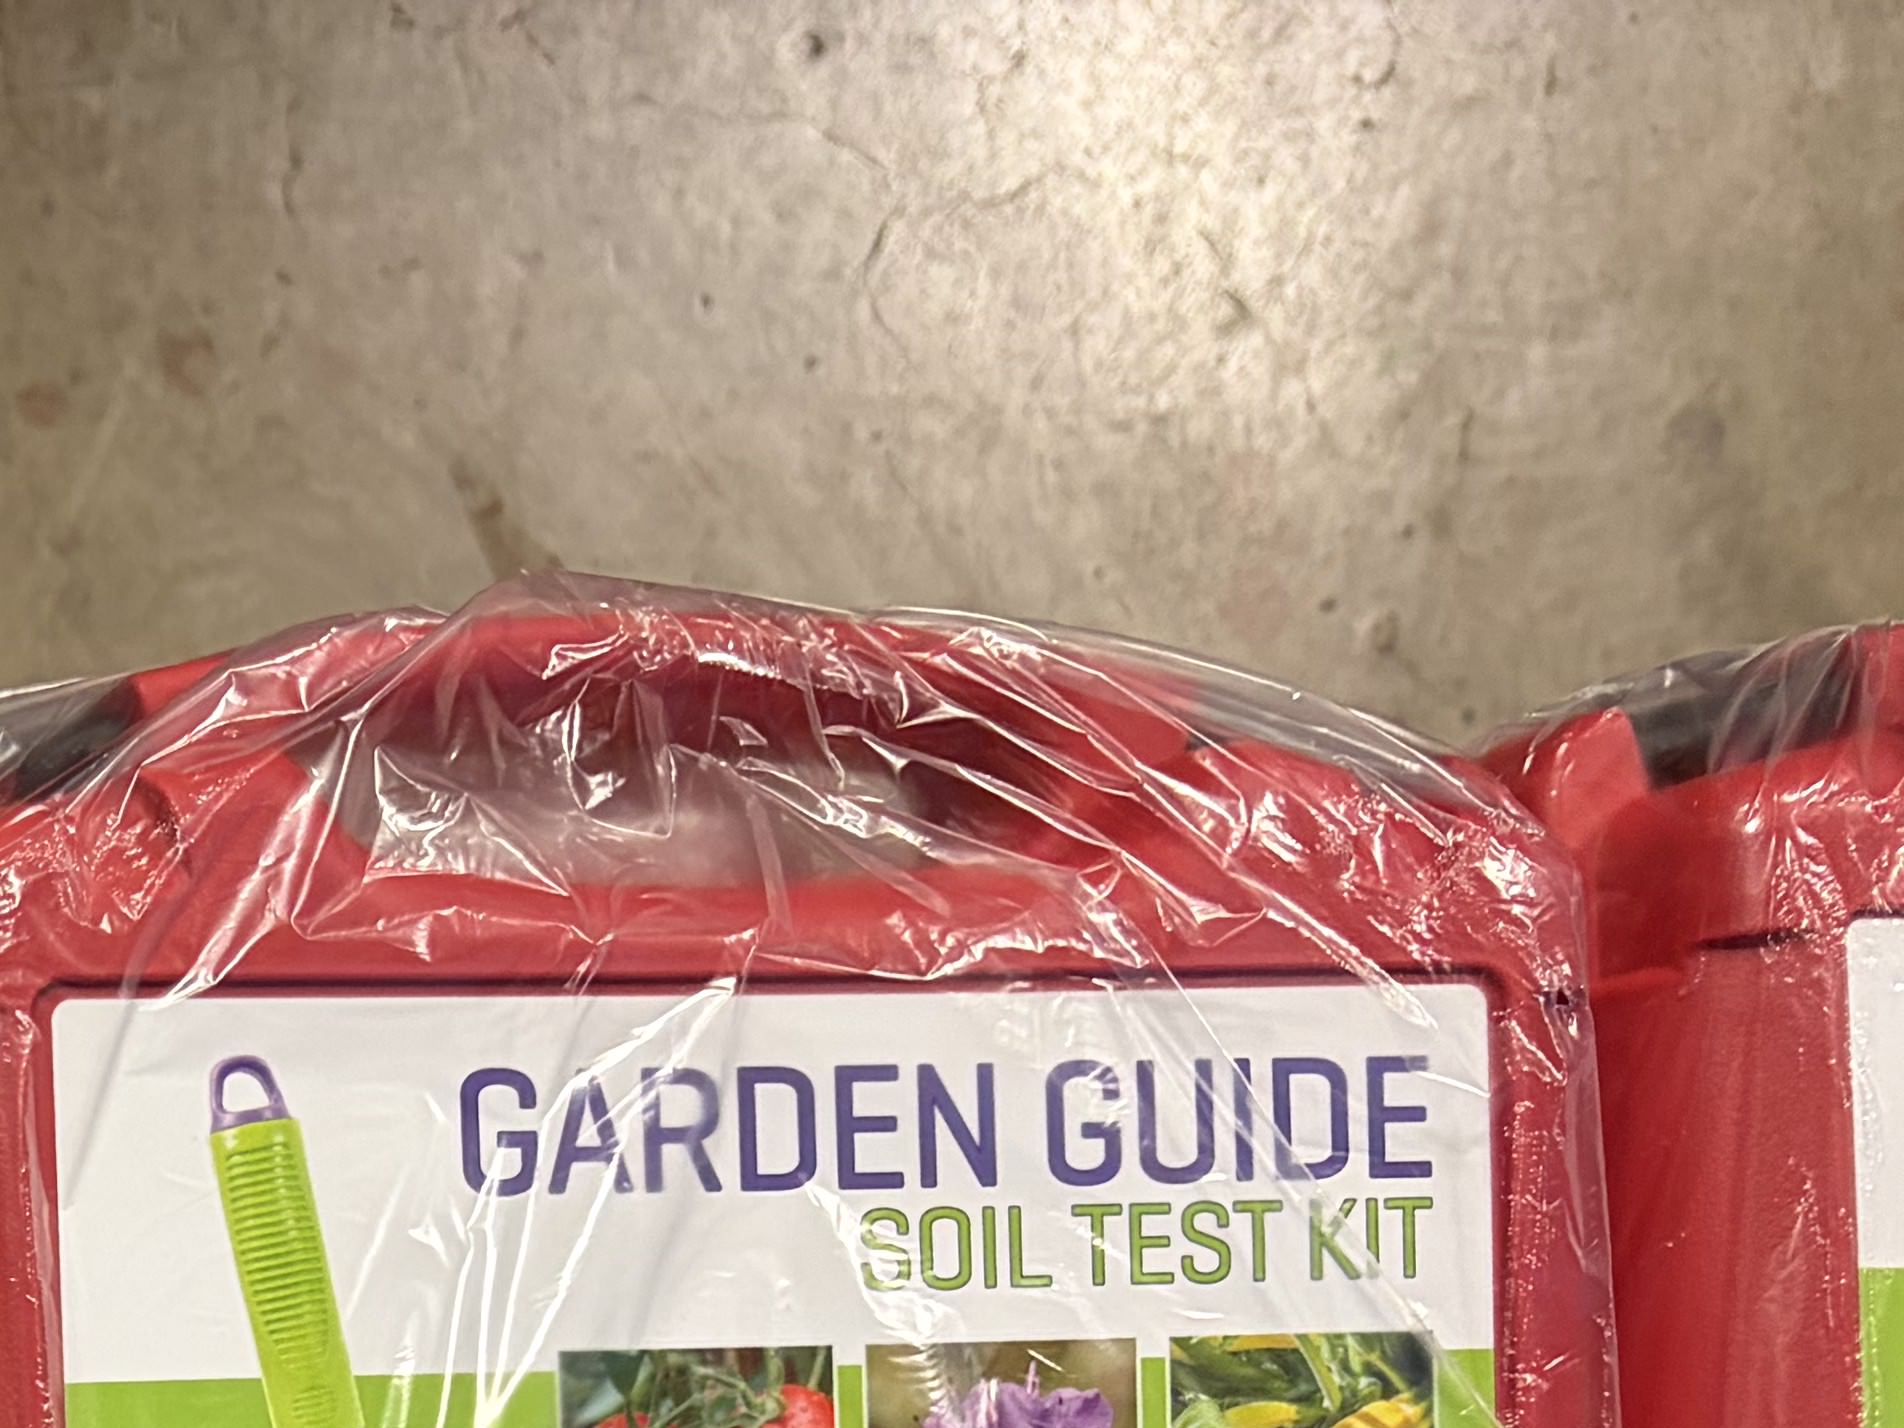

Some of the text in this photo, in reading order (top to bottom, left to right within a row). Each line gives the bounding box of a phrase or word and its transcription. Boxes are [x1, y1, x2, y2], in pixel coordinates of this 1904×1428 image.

[460, 1056, 1433, 1196] GARDEN GUIDE
[860, 1196, 1433, 1293] SOIL TEST KIT
